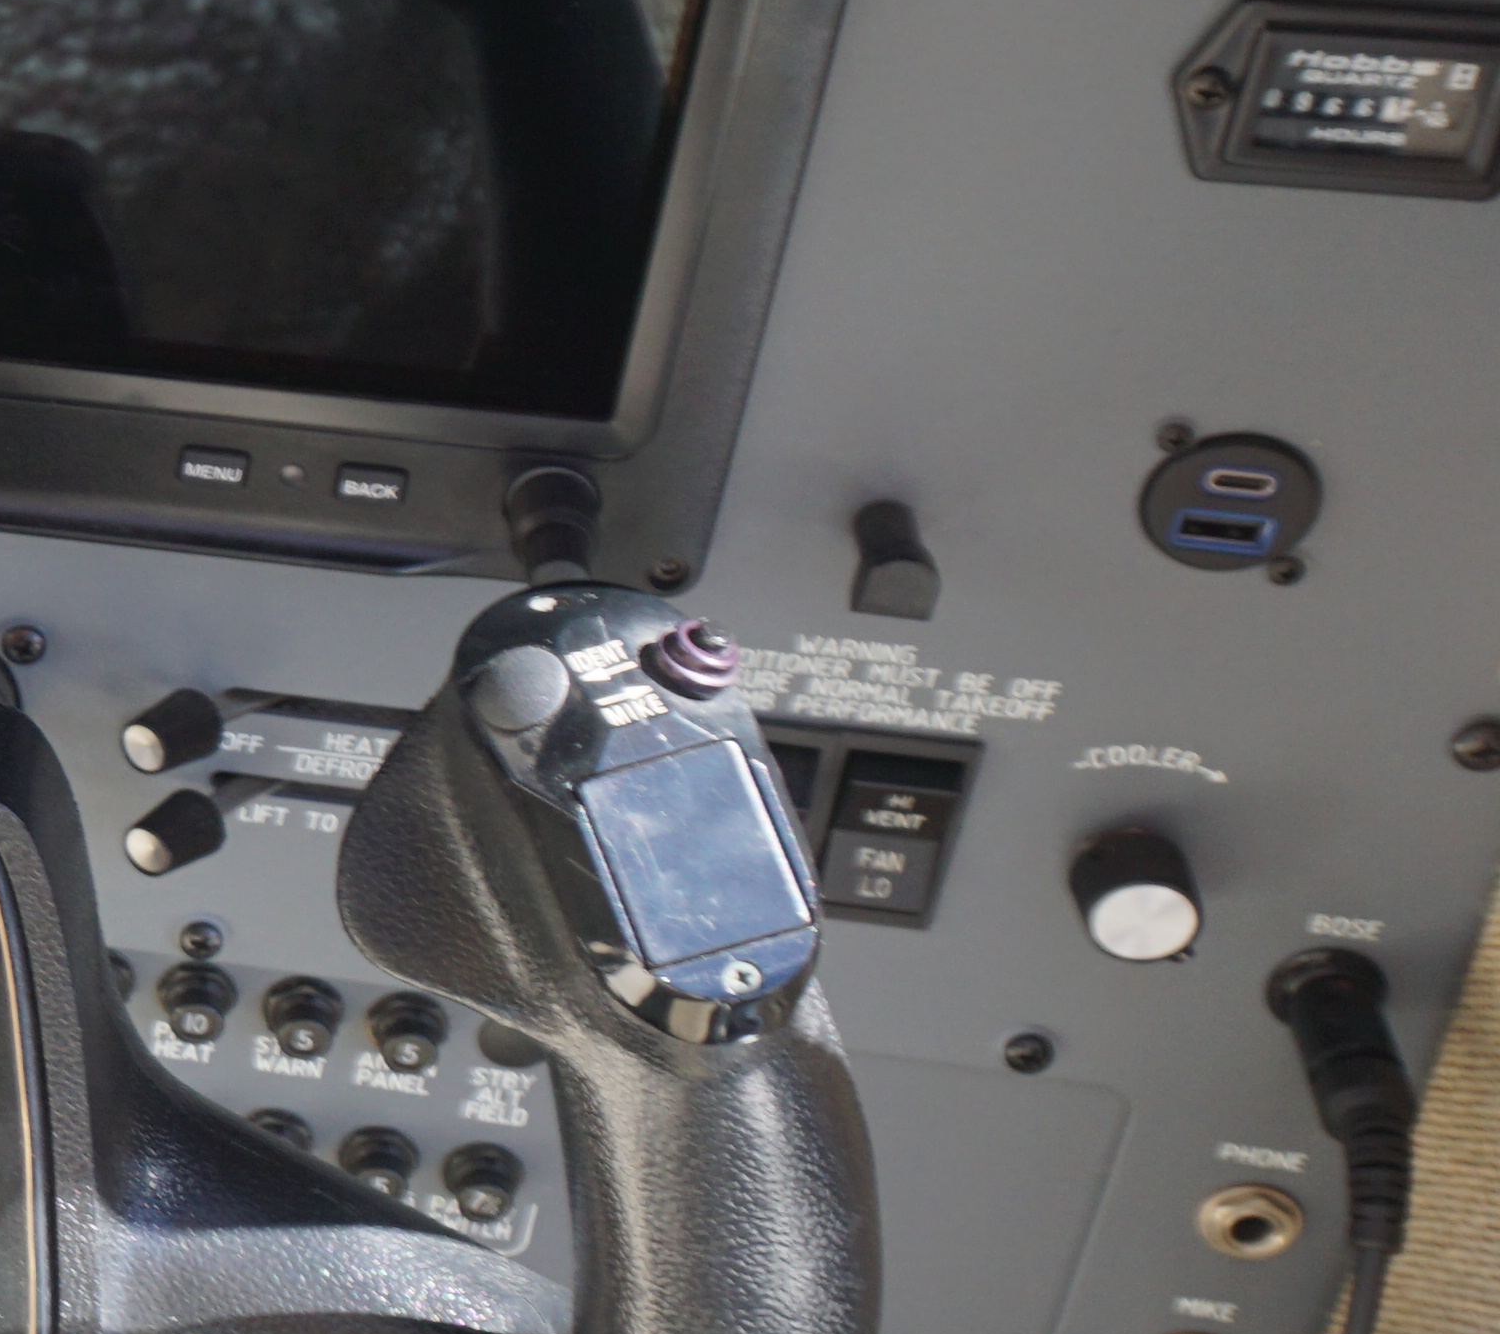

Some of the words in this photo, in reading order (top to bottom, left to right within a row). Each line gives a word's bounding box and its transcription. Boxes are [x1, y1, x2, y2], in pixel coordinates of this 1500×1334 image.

[183, 461, 244, 483] MENU
[342, 479, 400, 500] BACK
[563, 639, 629, 673] IDENT
[795, 633, 918, 666] WARNING
[737, 647, 853, 678] DITIONER
[866, 663, 943, 689] MUST
[954, 671, 995, 695] BE
[1009, 677, 1064, 700] OFF
[600, 693, 669, 727] MIKE
[807, 676, 913, 708] NORMAL
[933, 689, 1056, 721] TAKEOFF
[790, 693, 981, 734] PERFORMANCE
[323, 731, 391, 755] HEAT
[1088, 744, 1201, 774] COOLER
[237, 804, 290, 827] LIFT
[306, 810, 340, 833] TO
[854, 846, 906, 873] FAN
[856, 875, 893, 899] LO
[1310, 912, 1385, 942] BOSE
[152, 1038, 216, 1064] HEAT
[297, 1029, 315, 1051] 5
[400, 1042, 420, 1064] 5
[254, 1053, 328, 1080] WARN
[469, 1066, 538, 1091] STBY
[355, 1067, 430, 1096] PANEL
[476, 1086, 524, 1109] ALT
[464, 1103, 530, 1127] FIELD
[1173, 1295, 1240, 1323] MIKE
